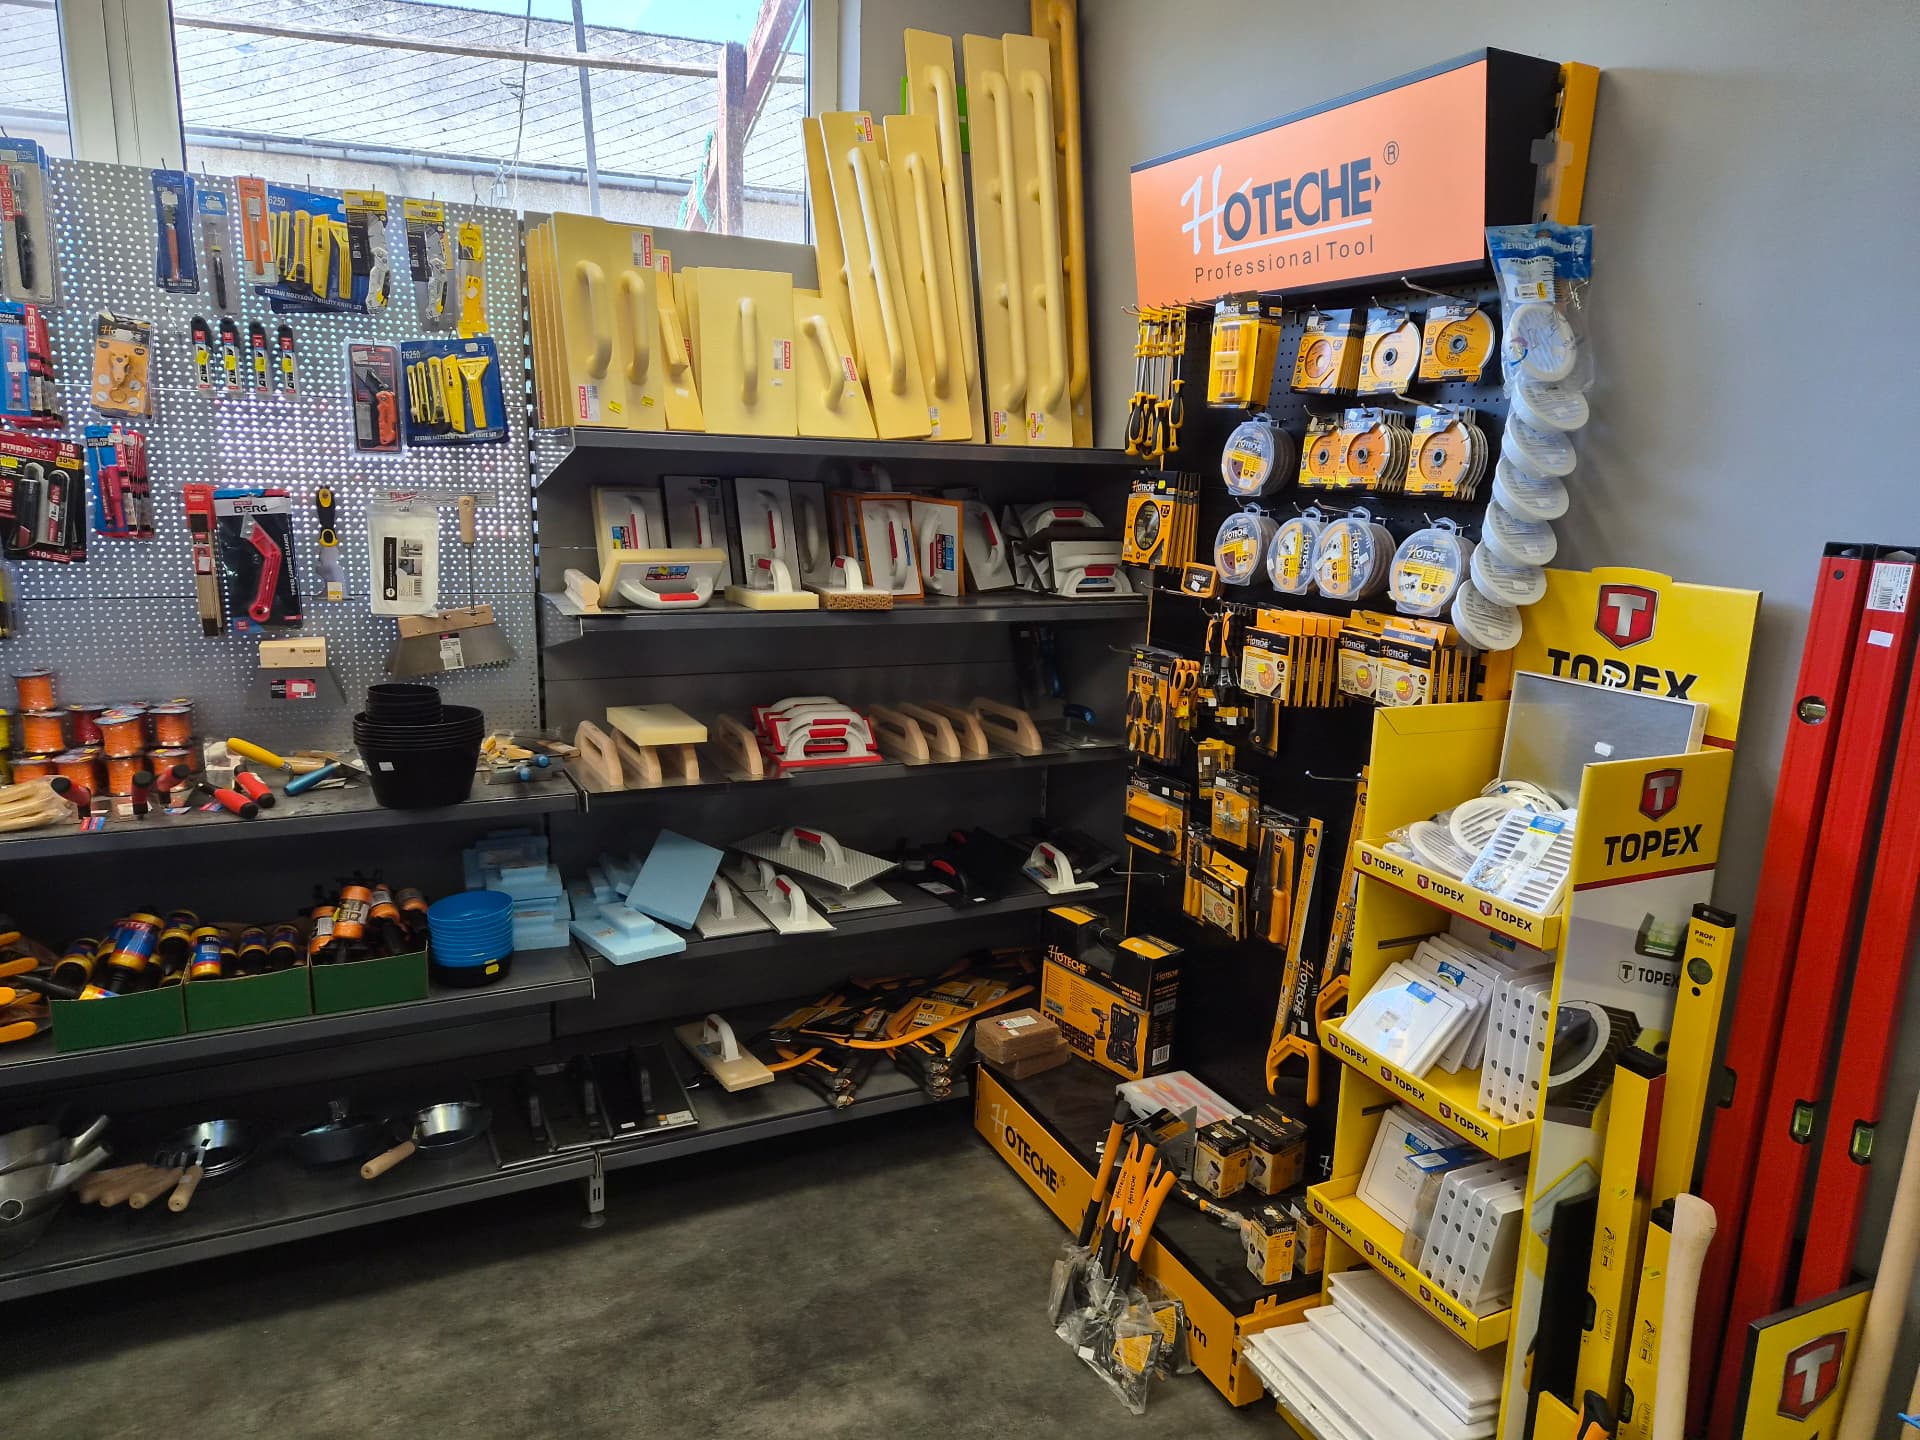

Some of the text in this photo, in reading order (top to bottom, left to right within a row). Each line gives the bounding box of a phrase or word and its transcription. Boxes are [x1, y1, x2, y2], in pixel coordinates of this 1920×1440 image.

[1181, 157, 1372, 254] HOTECHE
[1195, 235, 1374, 283] Professional Tool
[26, 307, 37, 350] FESTA
[0, 441, 33, 454] STREND
[59, 450, 75, 458] mm
[60, 442, 74, 452] 18
[1407, 544, 1448, 562] HOTECHE
[1381, 644, 1411, 660] HOTECHE
[1604, 823, 1703, 867] TOPEX
[1373, 857, 1404, 878] TOPEX
[1431, 881, 1465, 903] TOPEX
[1495, 908, 1533, 932] TOPEX
[1695, 929, 1716, 942] PROFI
[1048, 944, 1088, 977] HOTECHE
[1639, 967, 1680, 989] TOPEX
[1293, 959, 1314, 1018] HOTECHE
[1340, 1041, 1368, 1066] TOPEX
[1394, 1075, 1425, 1101] TOPEX
[1454, 1112, 1489, 1142] TOPEX
[991, 1103, 1058, 1196] HOTECHE
[1127, 1175, 1137, 1206] HOTECHE
[1325, 1209, 1352, 1237] TOPEX
[1376, 1251, 1406, 1281] TOPEX
[1433, 1297, 1468, 1330] TOPEX
